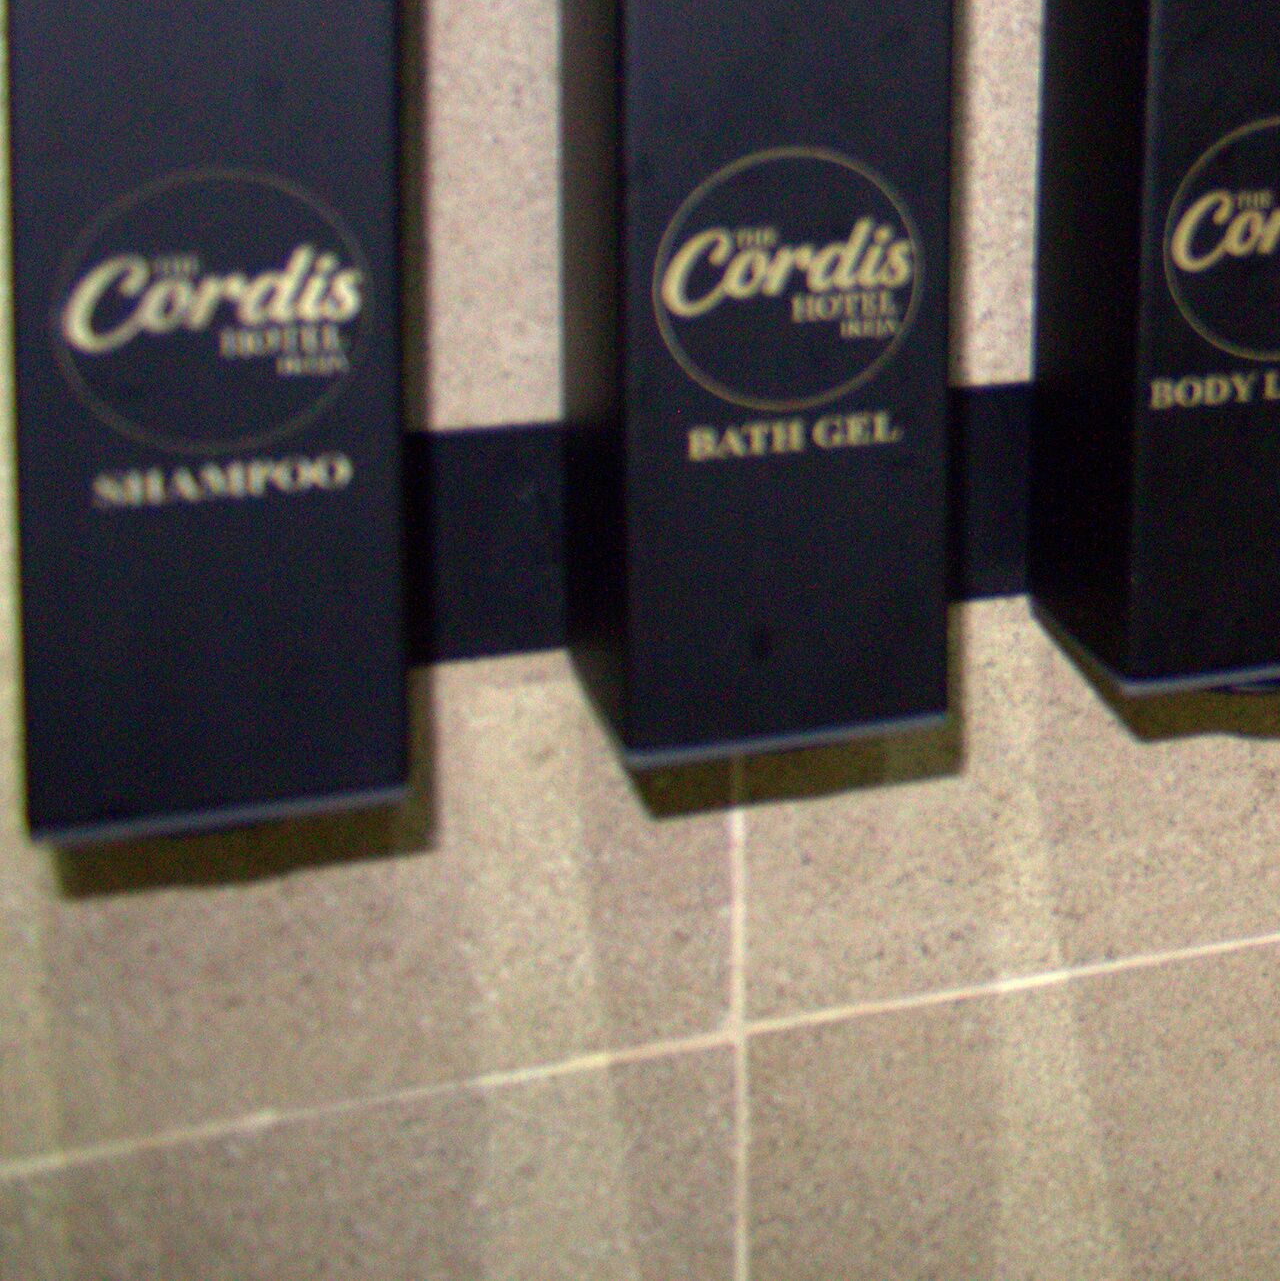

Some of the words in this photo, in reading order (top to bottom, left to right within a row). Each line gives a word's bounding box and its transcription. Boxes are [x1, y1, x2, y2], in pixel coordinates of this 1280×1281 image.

[63, 244, 362, 354] Cordis
[661, 218, 911, 317] Cordis
[1150, 372, 1256, 409] BODY
[687, 419, 805, 462] BATH
[811, 410, 903, 449] GEL
